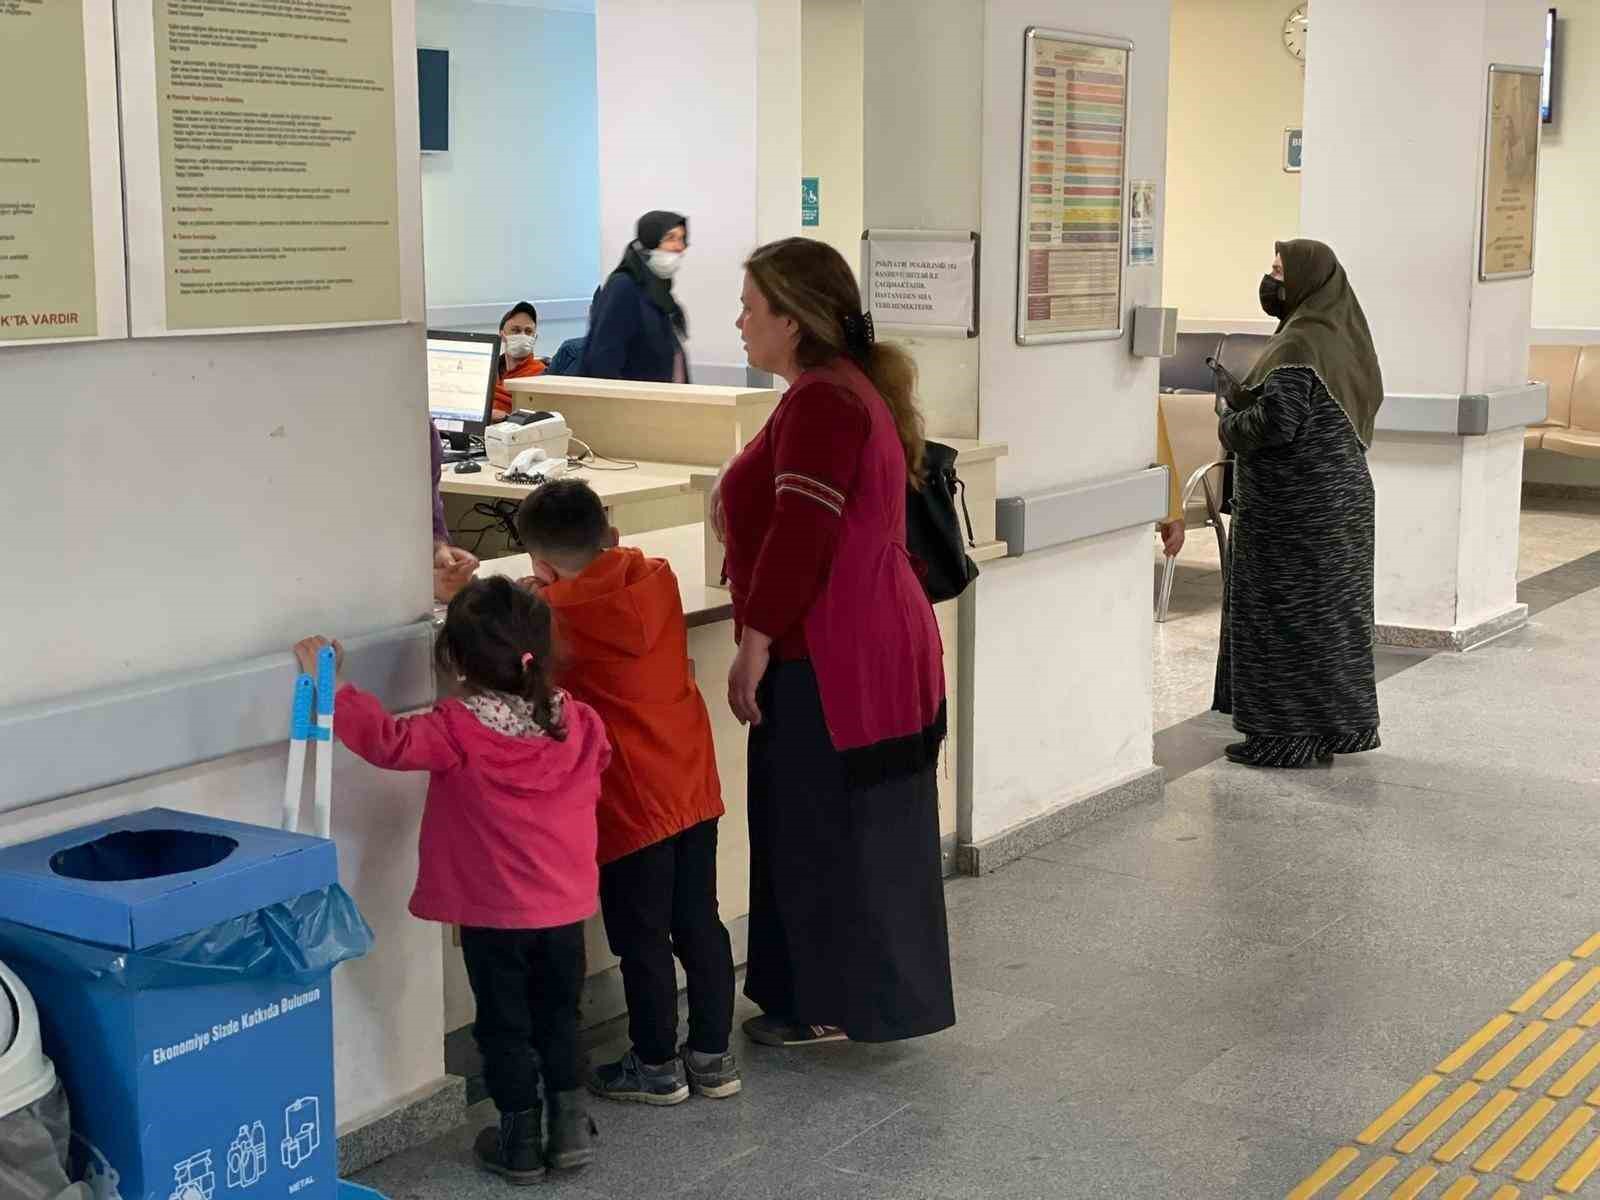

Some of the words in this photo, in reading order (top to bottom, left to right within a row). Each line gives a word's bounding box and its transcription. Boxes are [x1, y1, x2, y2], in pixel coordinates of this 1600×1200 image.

[32, 312, 79, 325] VARDIR
[153, 1031, 210, 1066] Ekonomiye
[212, 1020, 240, 1042] Sizde
[241, 1003, 280, 1030] Katkıda
[281, 988, 321, 1013] Bulunun
[289, 1176, 315, 1194] METAL
